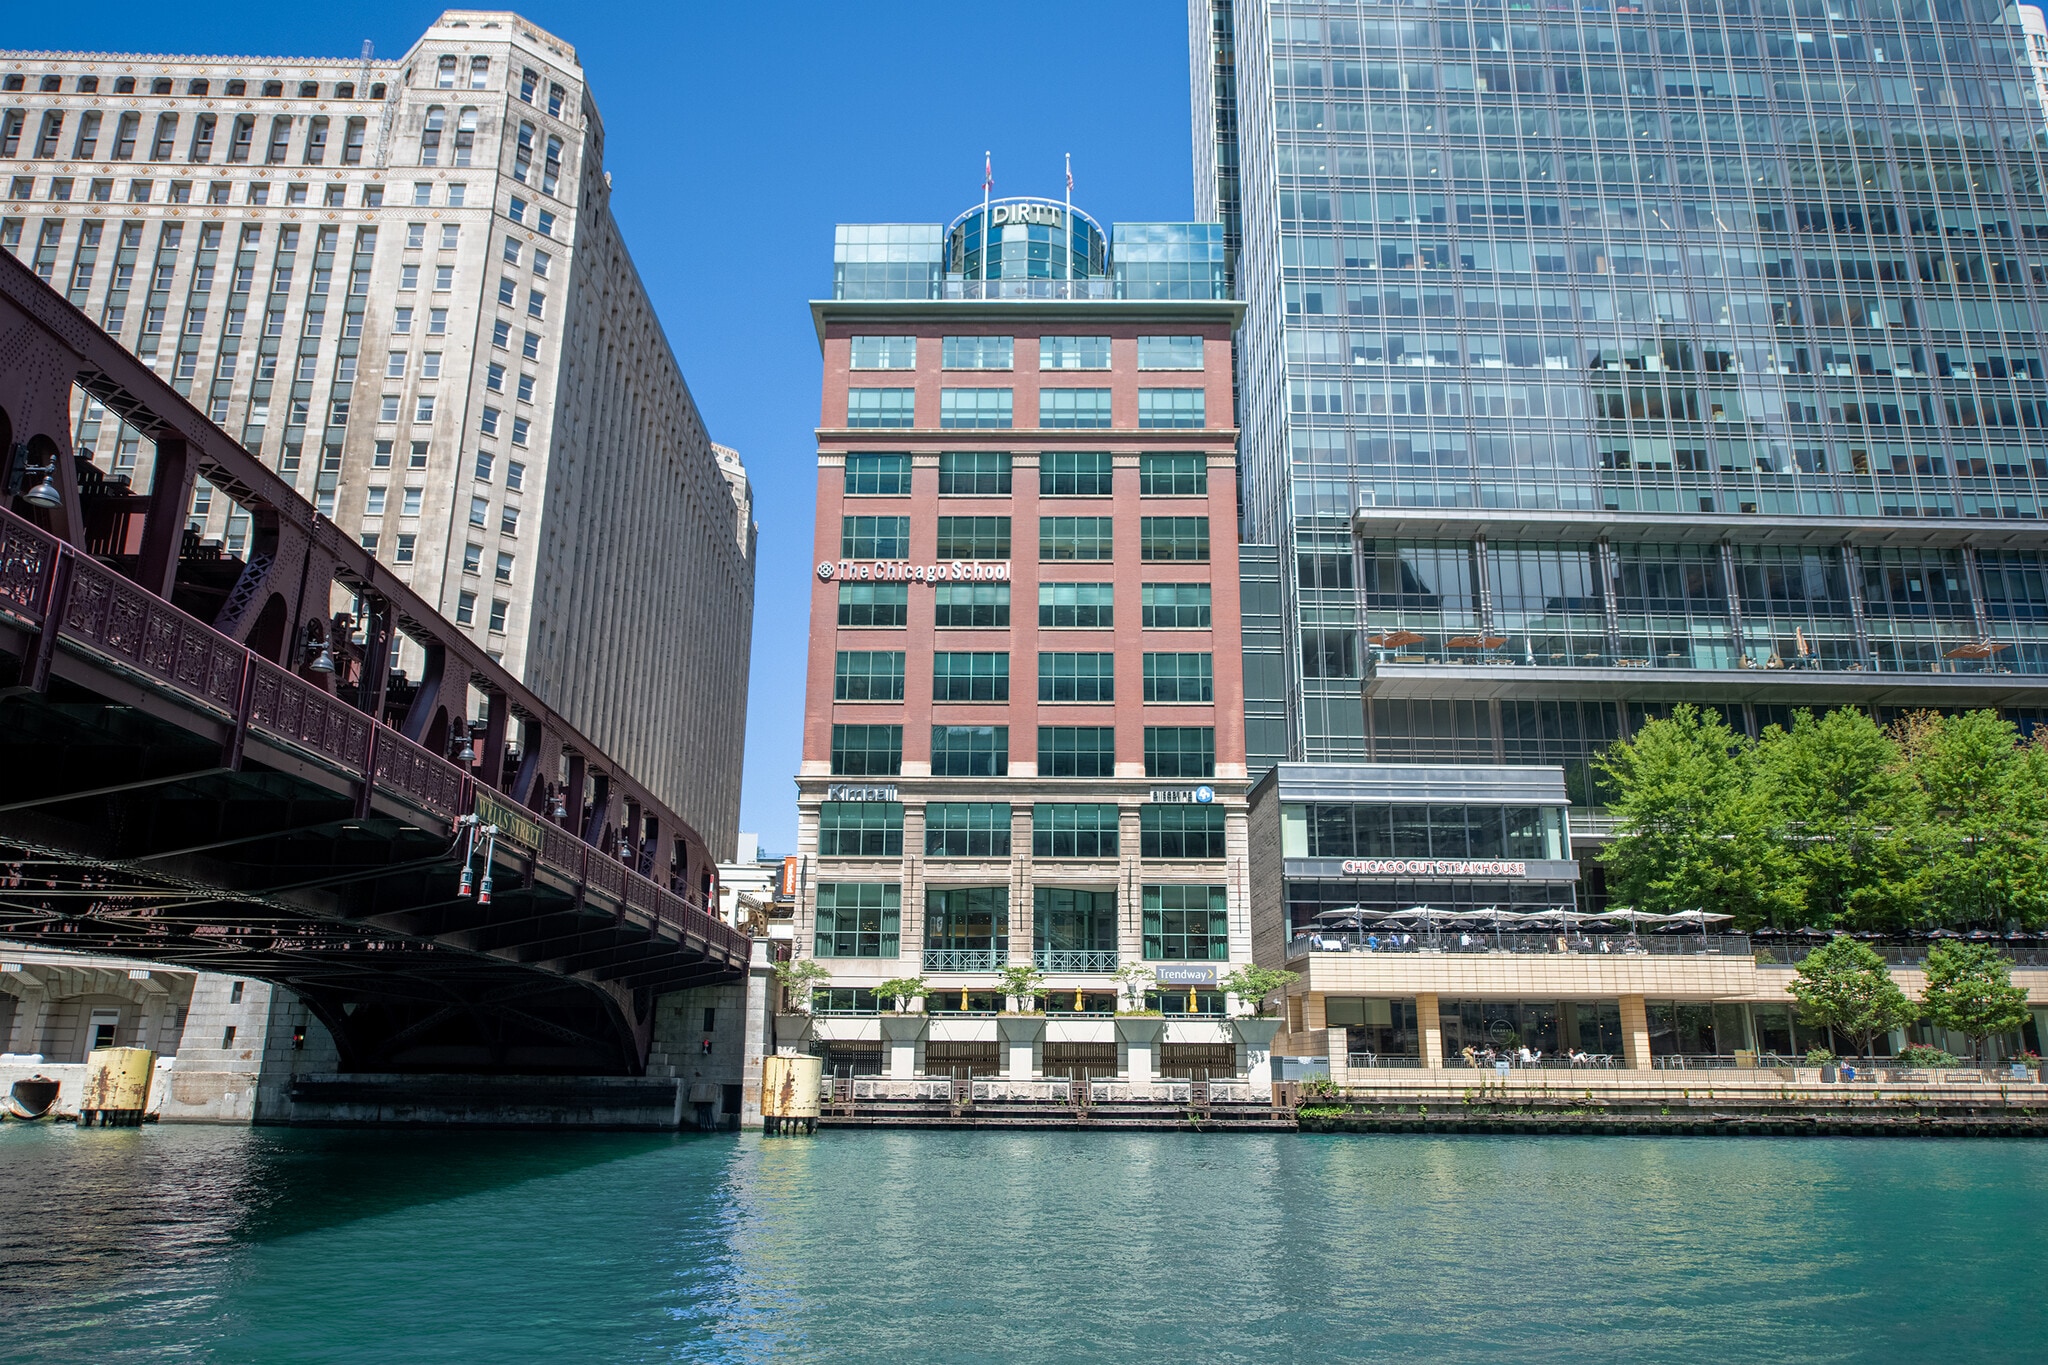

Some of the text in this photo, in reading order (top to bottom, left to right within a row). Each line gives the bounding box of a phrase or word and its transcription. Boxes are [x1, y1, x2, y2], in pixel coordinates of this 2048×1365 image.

[994, 203, 1060, 224] DIRTT
[838, 561, 1011, 582] The Chicago School
[829, 783, 896, 801] Kimball
[480, 799, 540, 846] WELLS STREET
[1342, 860, 1526, 876] CHICAGO CUT STEAKHOUSE
[1159, 968, 1207, 982] Trendway
